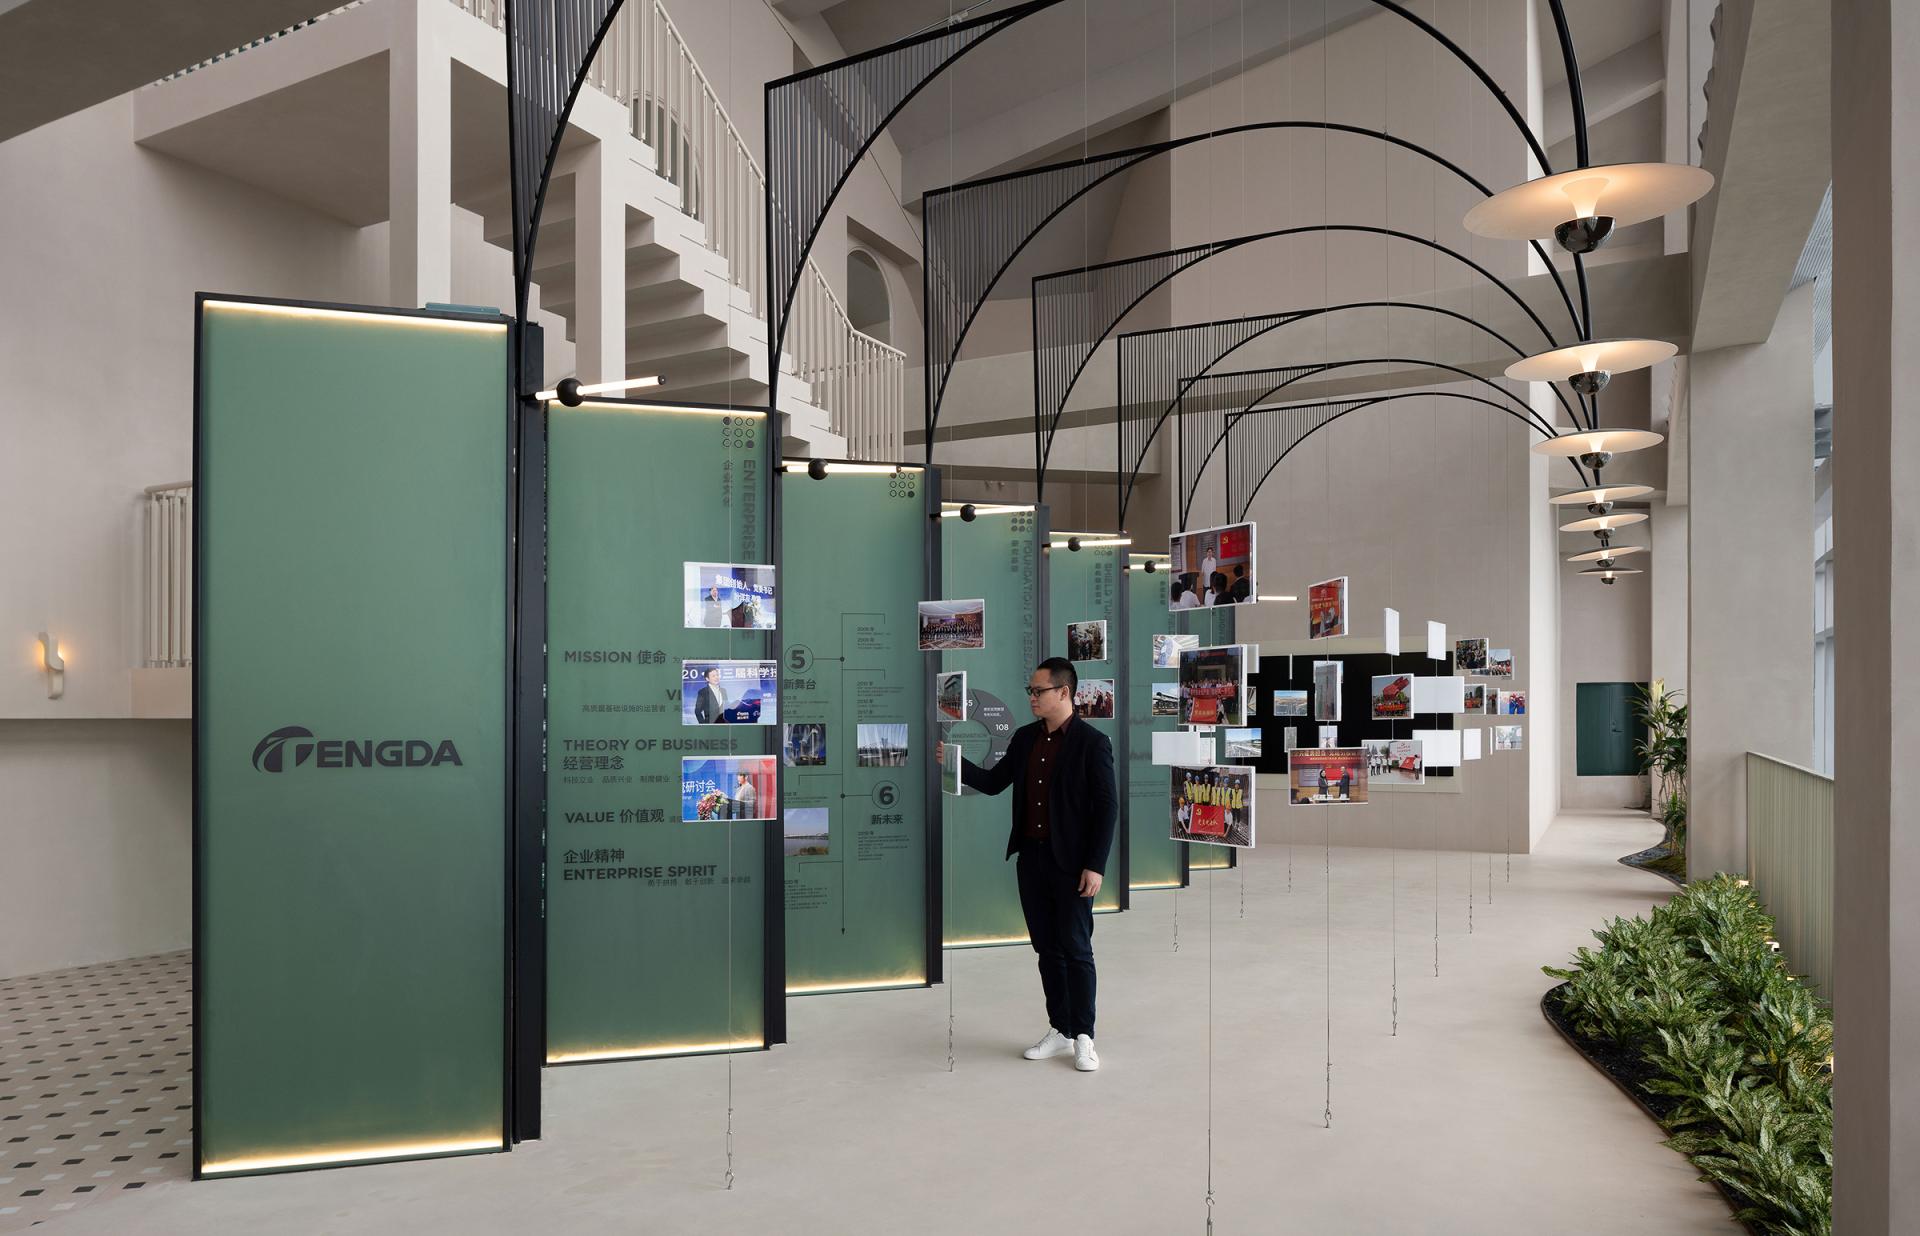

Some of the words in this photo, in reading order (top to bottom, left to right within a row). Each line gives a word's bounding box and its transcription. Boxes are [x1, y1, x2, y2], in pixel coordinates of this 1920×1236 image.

[743, 459, 756, 561] ENTERPRISE
[564, 649, 632, 664] MISSION
[637, 649, 667, 665] 使命
[791, 649, 805, 670] 5
[995, 723, 1009, 731] 108
[563, 738, 630, 751] THEORY
[635, 739, 658, 751] OF
[662, 738, 738, 751] BUSINESS
[563, 755, 625, 771] 经营理念
[879, 785, 895, 806] 6
[565, 811, 615, 824] VALUE
[619, 809, 665, 824] 价值观
[871, 814, 904, 826] 新未来
[563, 848, 625, 864] 企业精神
[563, 866, 663, 881] ENTERPRISE
[668, 865, 718, 878] SPIRIT
